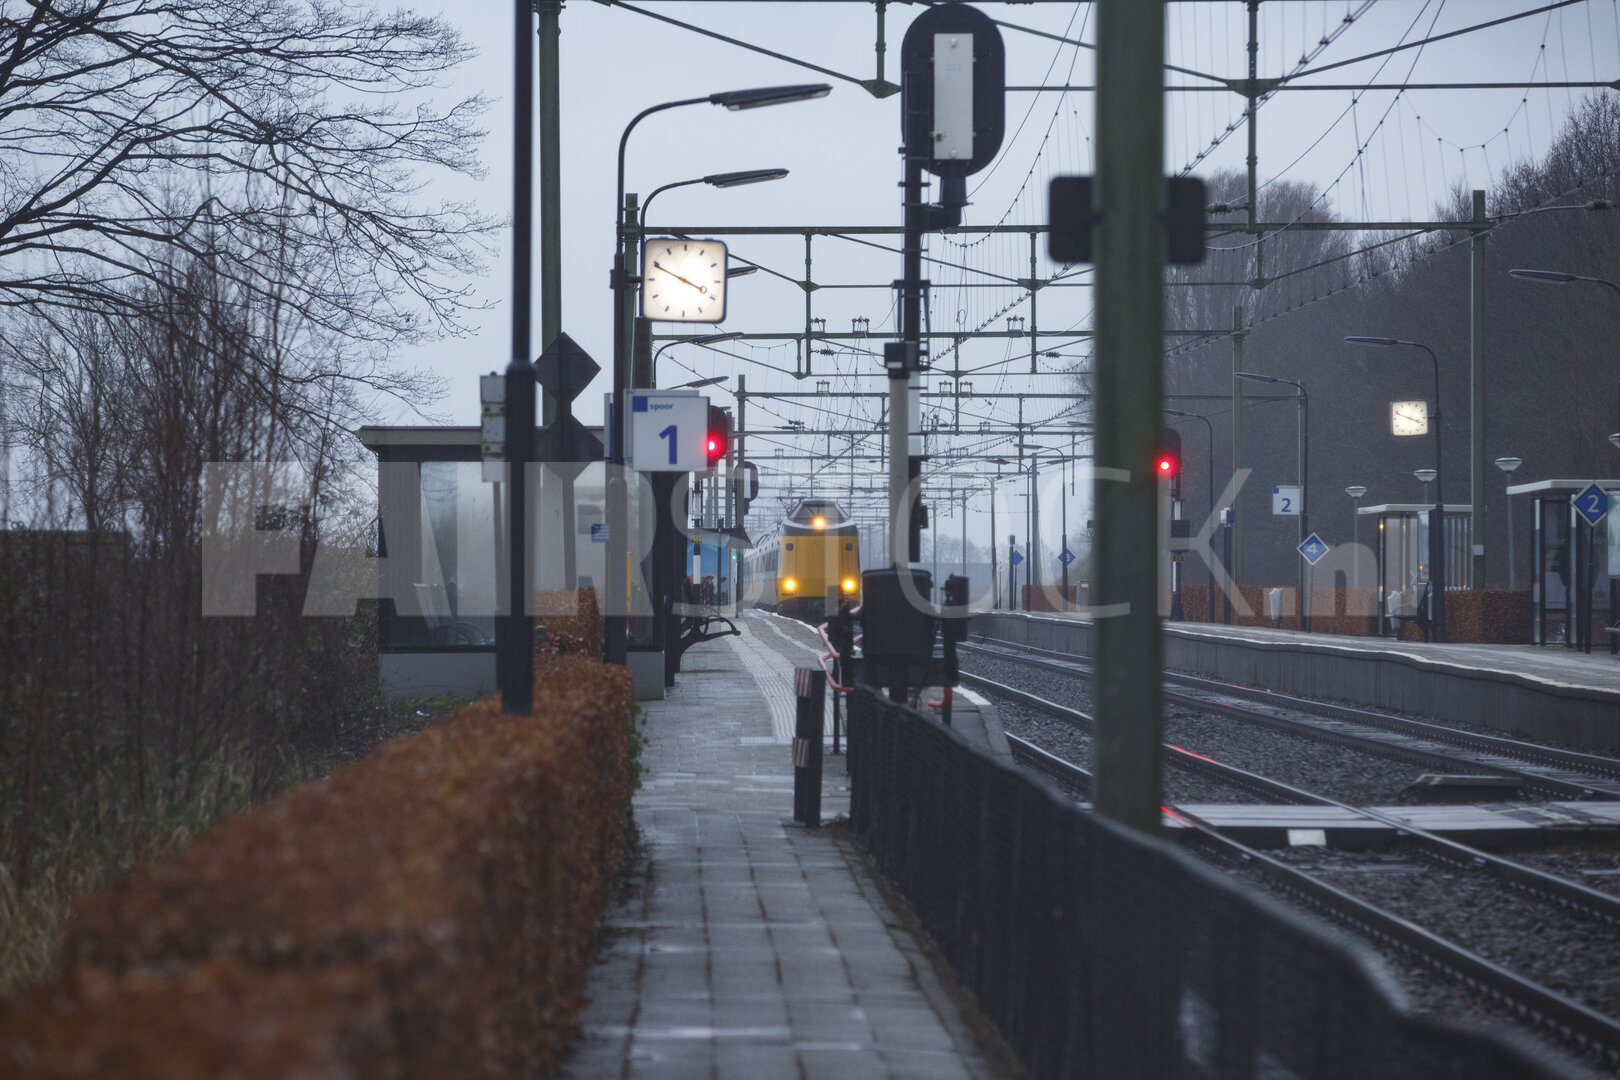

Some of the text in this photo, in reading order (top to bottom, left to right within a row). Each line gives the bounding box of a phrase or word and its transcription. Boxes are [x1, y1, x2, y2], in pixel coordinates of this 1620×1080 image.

[650, 403, 673, 411] spoor
[659, 425, 678, 465] 1
[1281, 497, 1292, 513] 2
[1587, 494, 1600, 513] 2
[1306, 542, 1319, 555] 4
